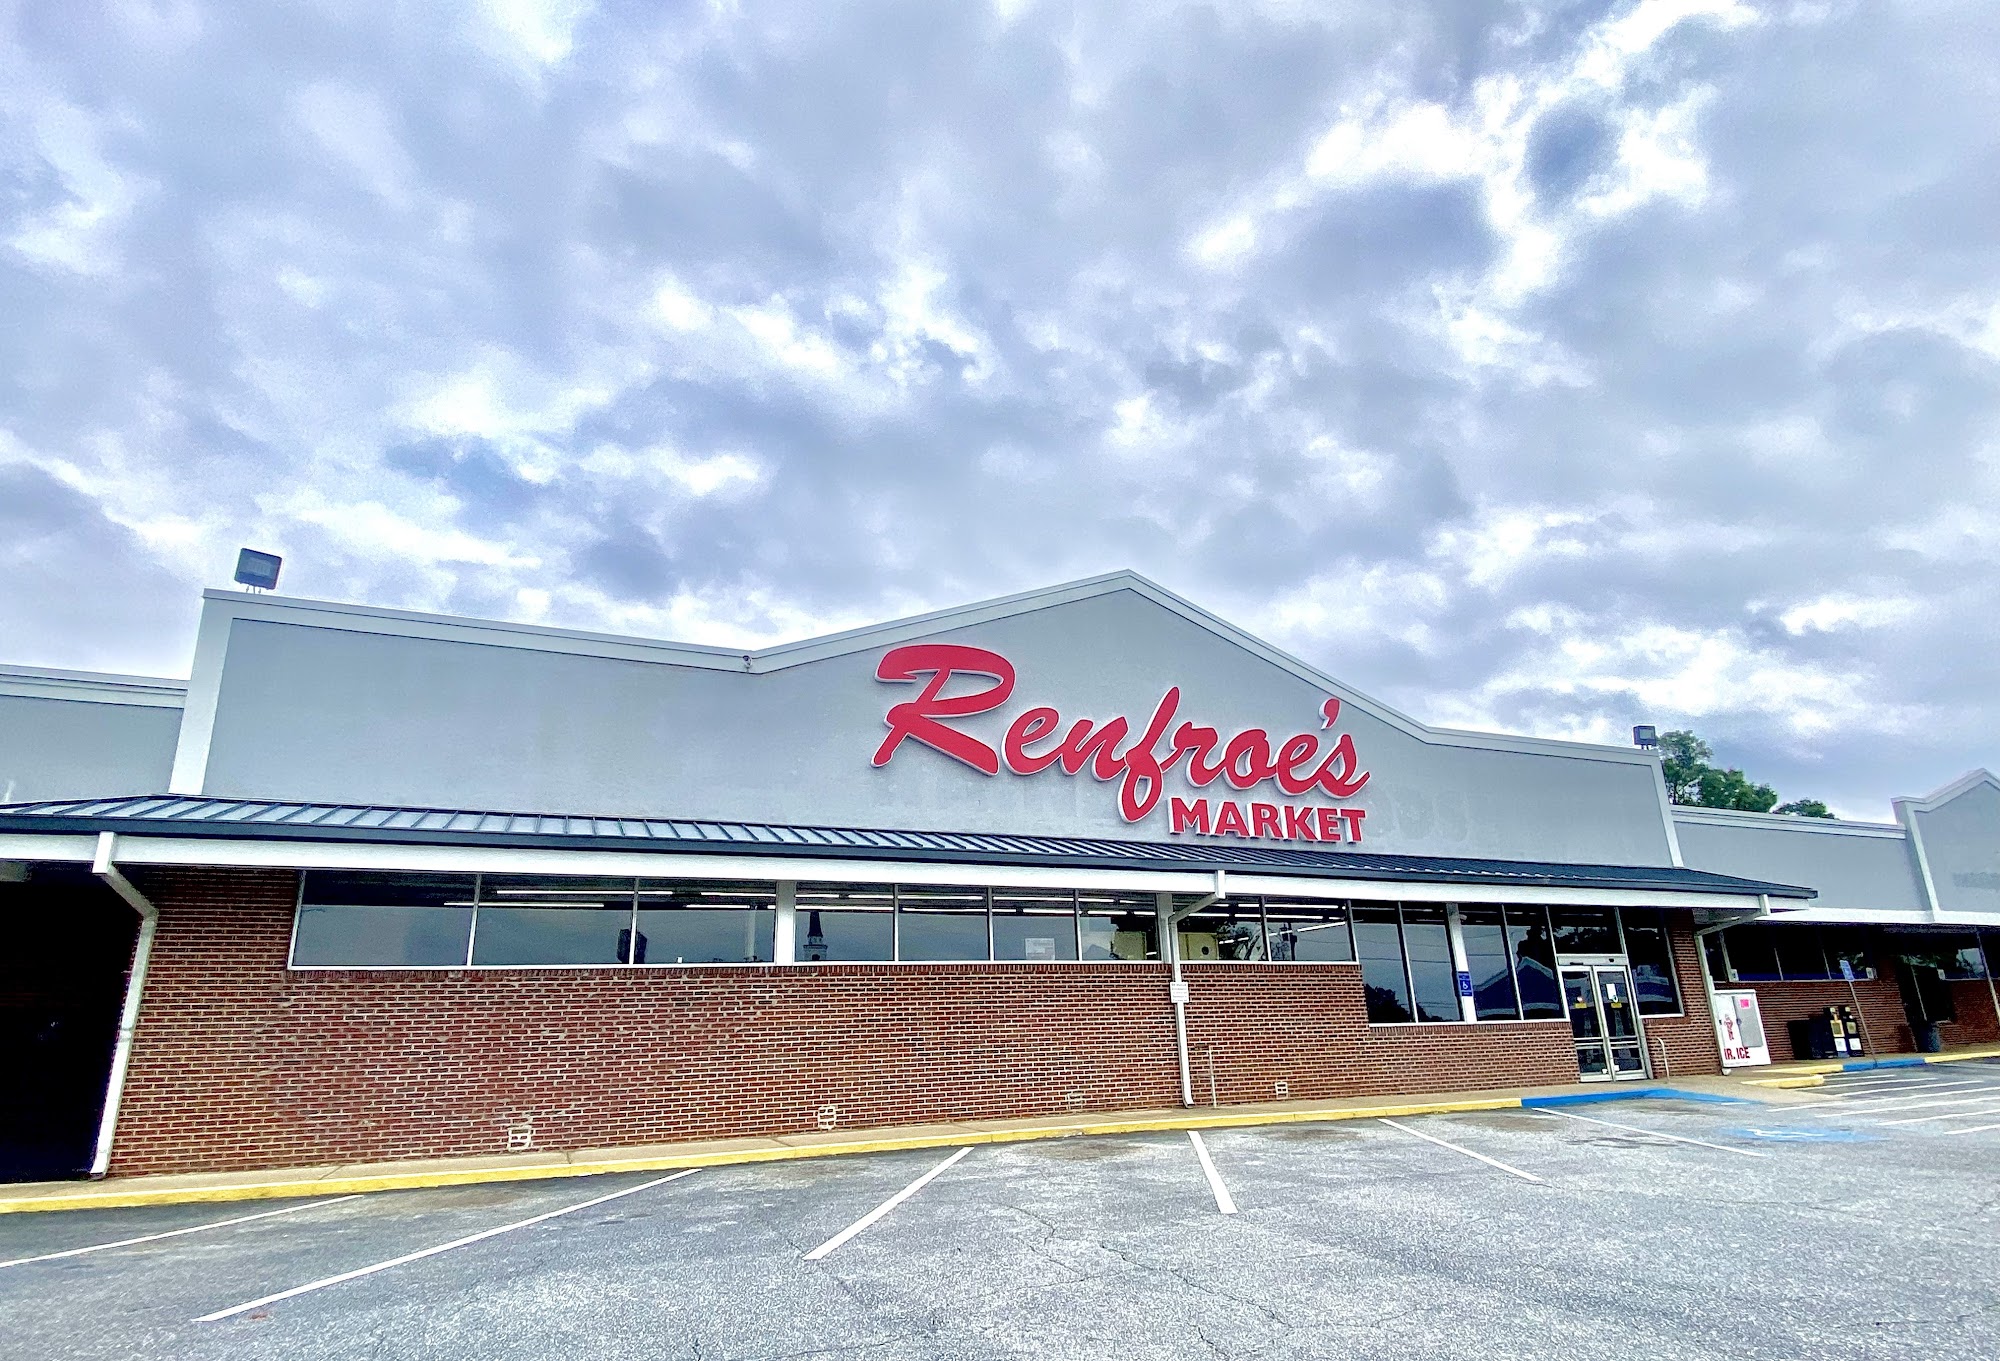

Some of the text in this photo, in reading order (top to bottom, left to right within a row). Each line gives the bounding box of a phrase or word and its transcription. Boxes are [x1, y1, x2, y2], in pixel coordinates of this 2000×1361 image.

[872, 644, 1370, 823] Renfroe's
[1168, 797, 1366, 842] MARKET
[1736, 1047, 1750, 1059] ICE
